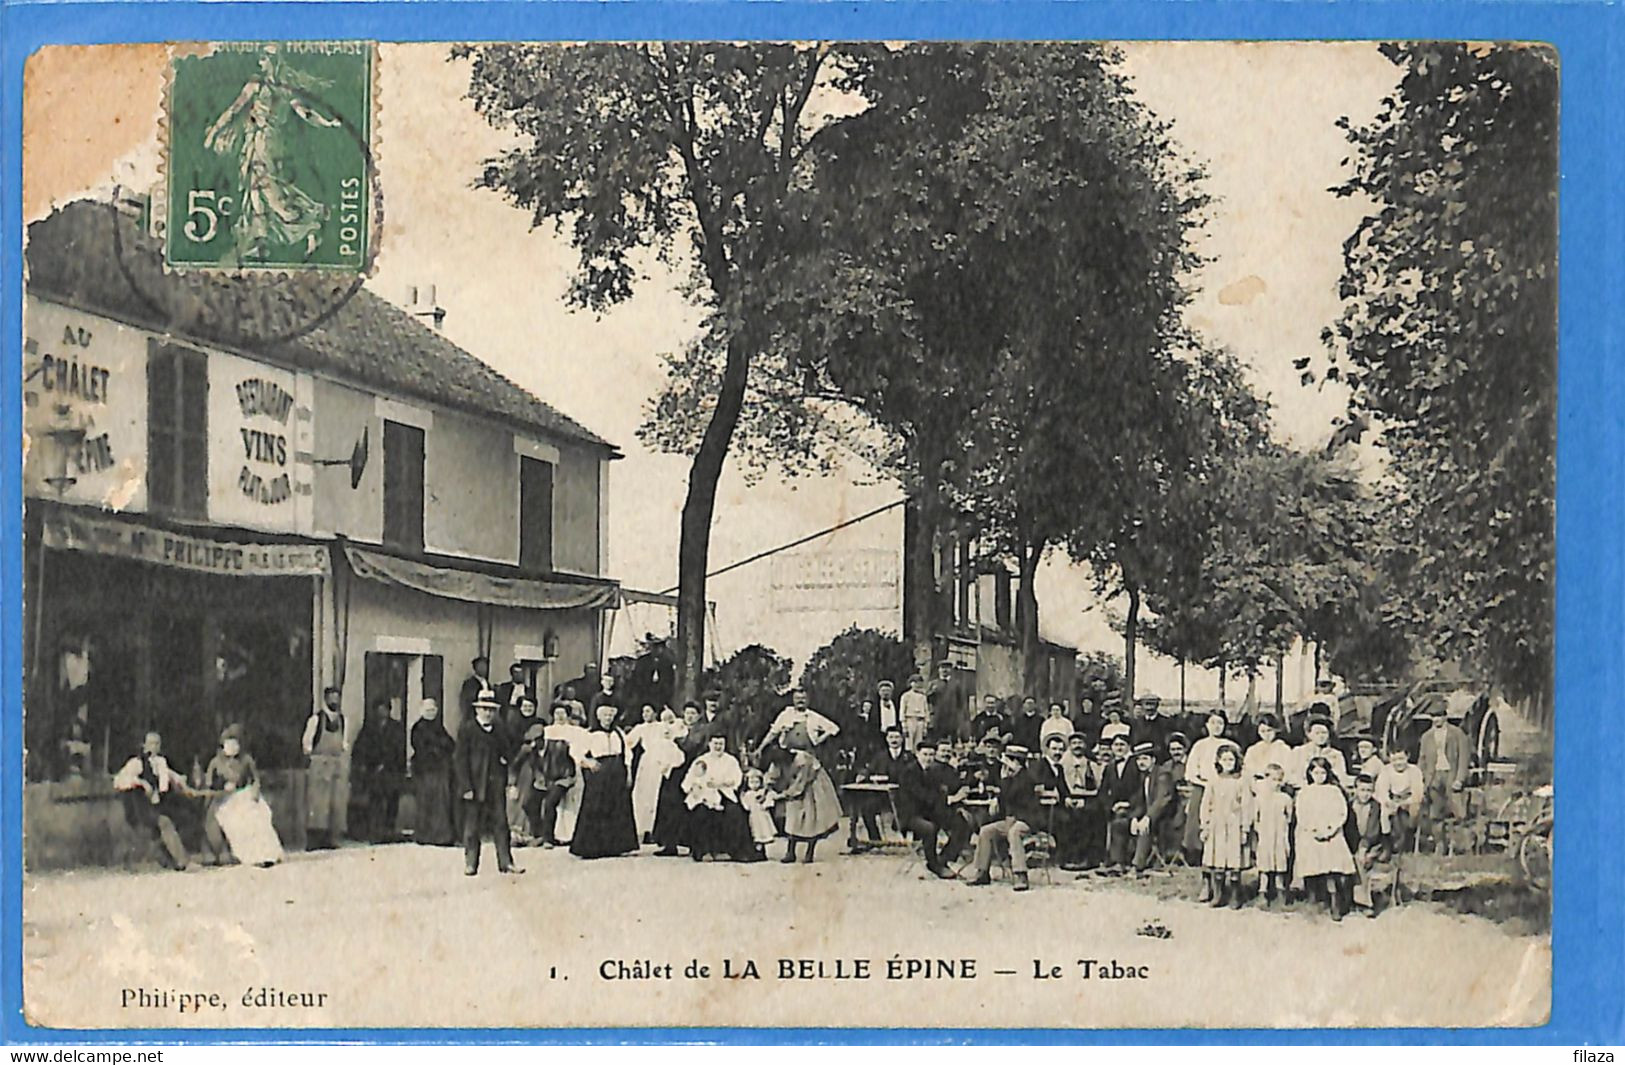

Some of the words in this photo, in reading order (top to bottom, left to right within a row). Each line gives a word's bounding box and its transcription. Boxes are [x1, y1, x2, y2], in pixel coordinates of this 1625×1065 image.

[339, 177, 360, 256] POSTES
[62, 325, 93, 348] AU
[240, 428, 287, 467] VINS
[164, 537, 243, 570] PHILIPPE
[599, 960, 673, 981] Châlet
[684, 959, 711, 980] de
[723, 960, 761, 980] LA
[777, 959, 871, 980] BELLE
[886, 953, 978, 980] ÉPINE
[1033, 959, 1064, 980] Le
[1077, 959, 1150, 980] Tabac
[241, 986, 329, 1008] éditeur
